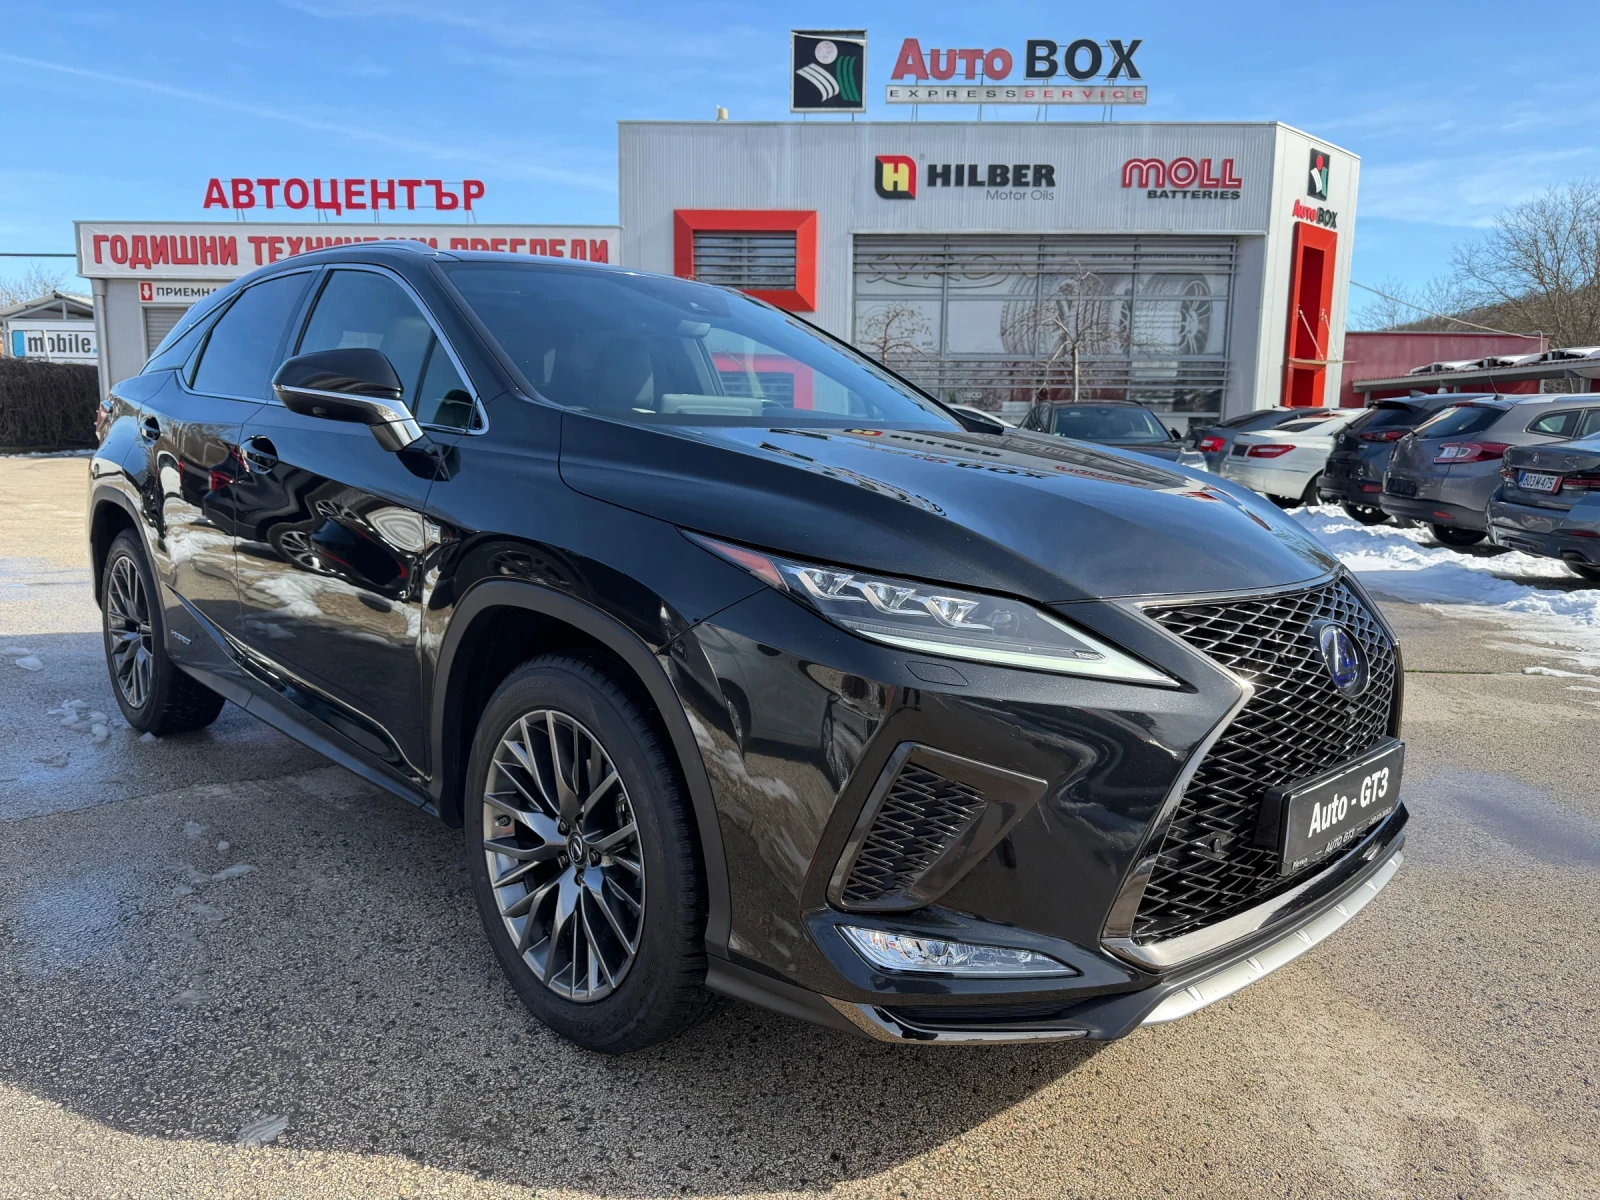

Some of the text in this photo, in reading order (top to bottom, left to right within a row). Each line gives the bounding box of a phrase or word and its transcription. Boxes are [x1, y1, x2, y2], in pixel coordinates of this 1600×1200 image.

[1024, 38, 1144, 81] BOX
[927, 164, 1056, 187] HILBER
[203, 178, 485, 216] АВТОЦЕНТЪР
[986, 189, 1055, 200] Motor Oils
[1147, 190, 1241, 200] BATTERIES
[93, 234, 237, 269] ГОДИШНИ
[156, 287, 217, 298] ПРИЕМН
[1308, 794, 1348, 838] Auto
[1360, 767, 1389, 808] GT3
